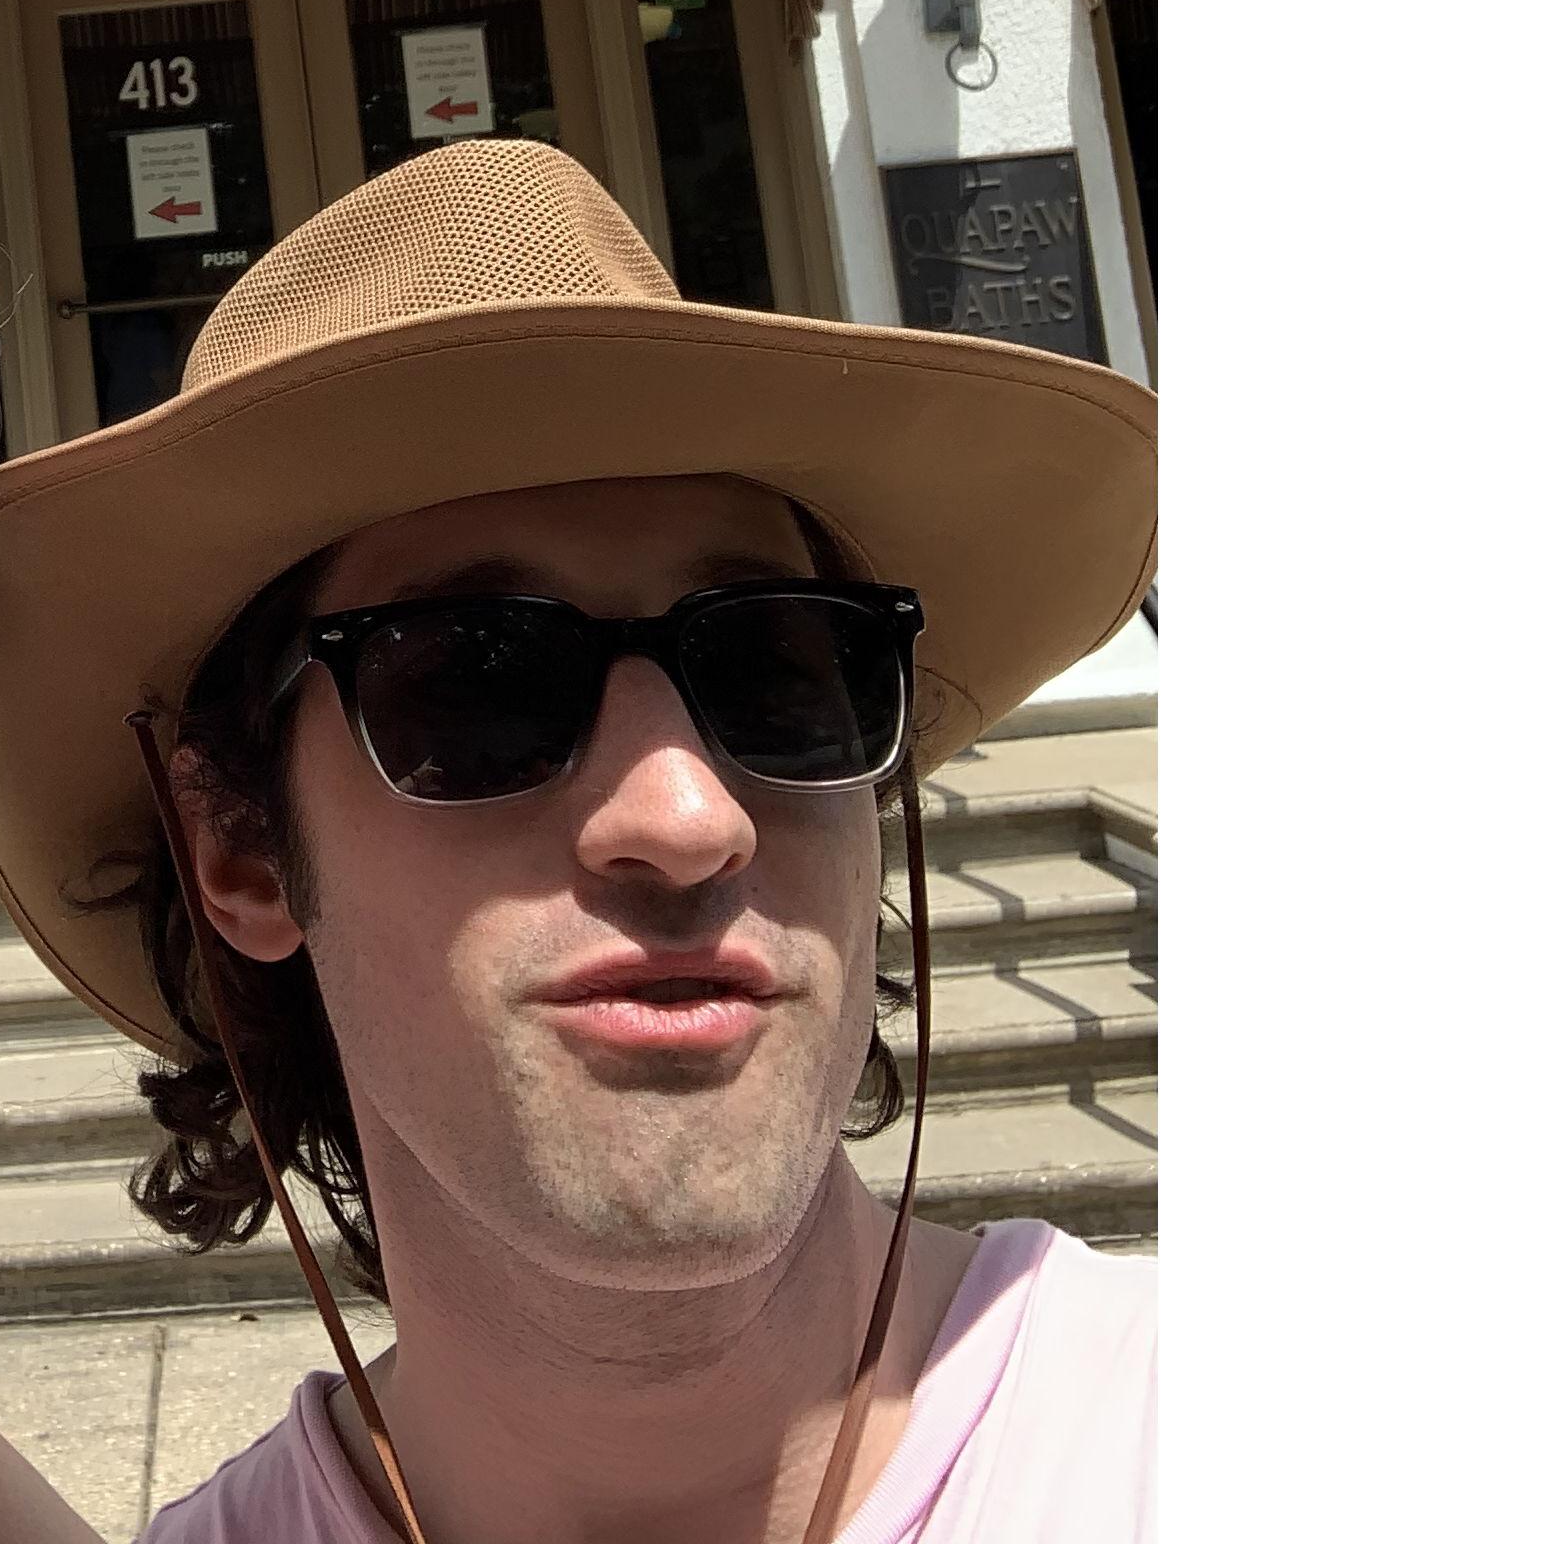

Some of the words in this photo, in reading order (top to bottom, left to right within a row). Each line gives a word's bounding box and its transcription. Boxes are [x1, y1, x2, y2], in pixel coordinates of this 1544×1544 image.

[118, 56, 198, 110] 413
[202, 250, 248, 268] PUSH
[901, 196, 1078, 272] QUAPAW
[926, 273, 1074, 332] BATHS
